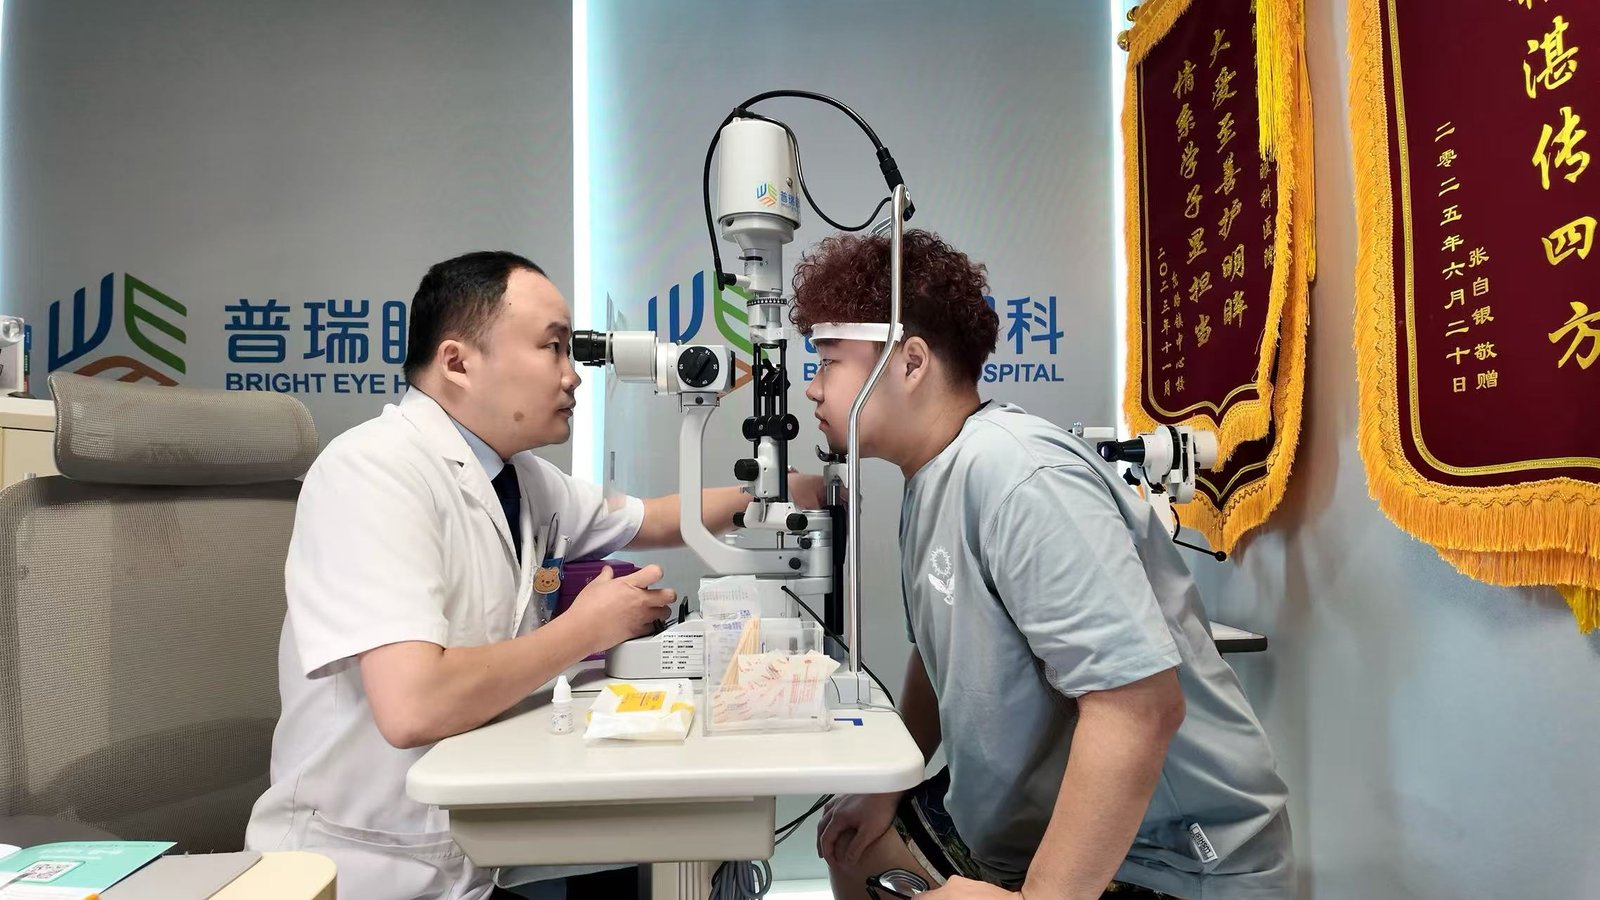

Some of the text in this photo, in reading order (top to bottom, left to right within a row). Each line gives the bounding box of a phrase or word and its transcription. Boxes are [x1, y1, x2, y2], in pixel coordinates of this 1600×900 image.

[1435, 121, 1470, 393] 二零二五年六月二十日
[1509, 0, 1600, 370] 湛传四方
[225, 373, 326, 394] BRIGHT
[334, 373, 386, 394] EYE
[977, 363, 1065, 383] SPITAL
[1468, 246, 1498, 390] 张自银敬赠
